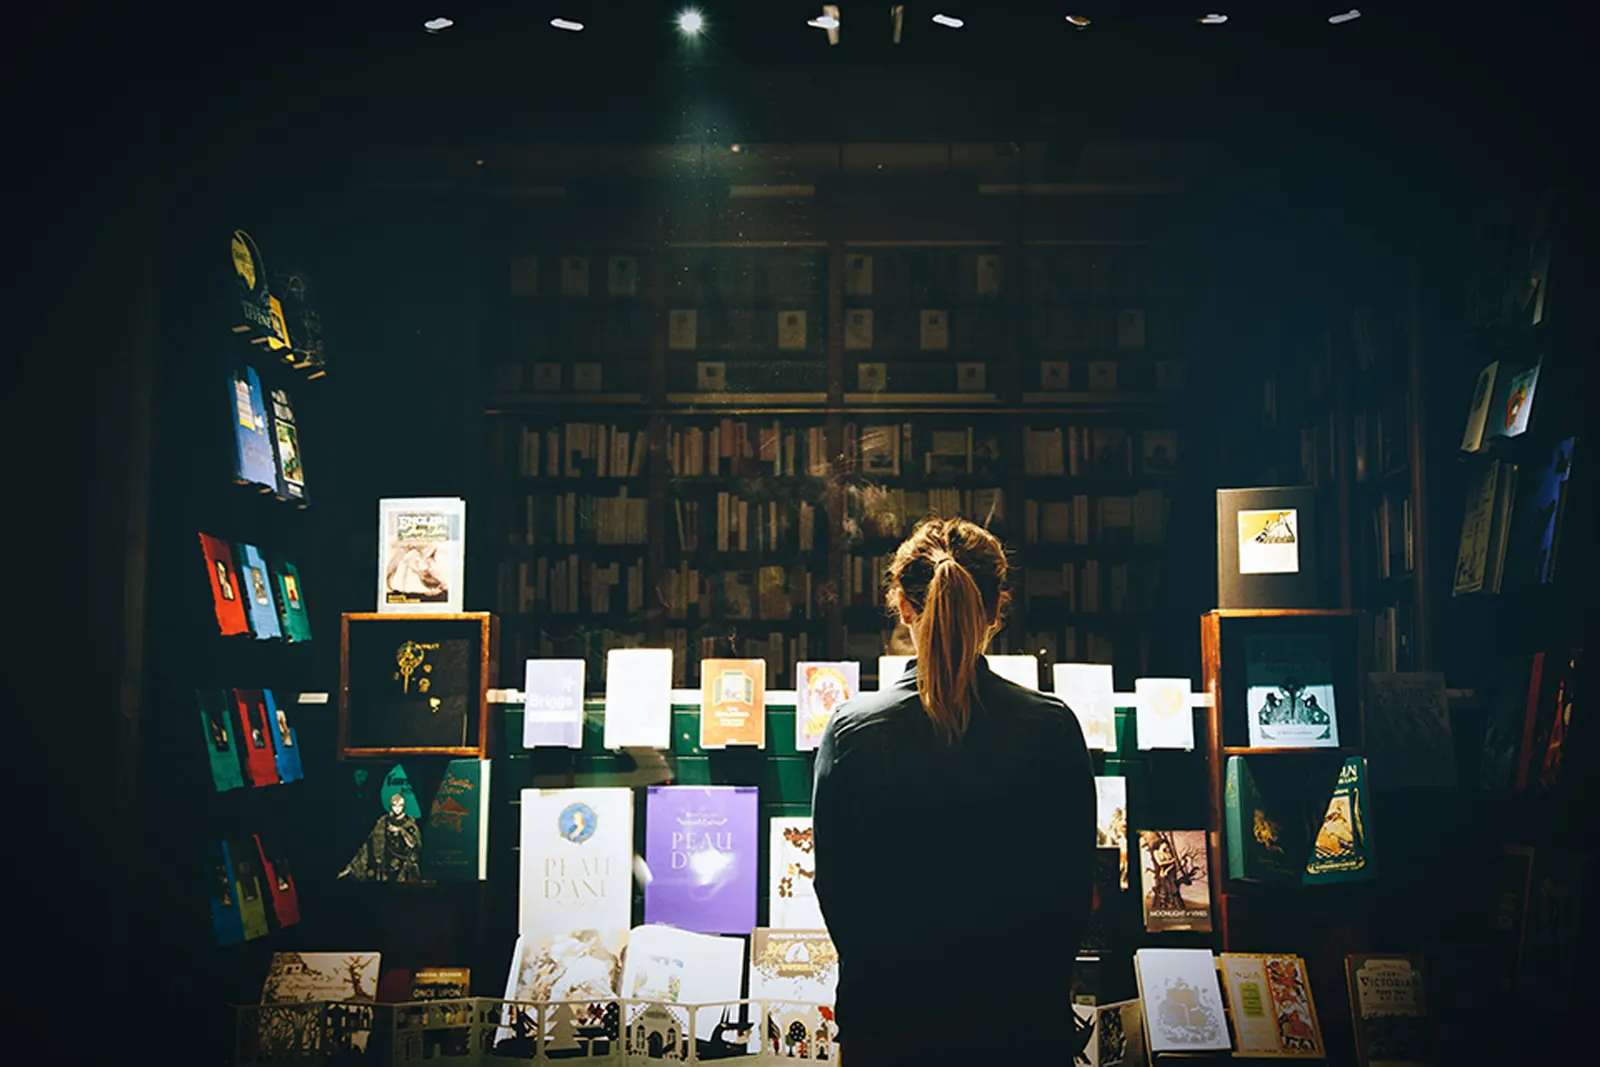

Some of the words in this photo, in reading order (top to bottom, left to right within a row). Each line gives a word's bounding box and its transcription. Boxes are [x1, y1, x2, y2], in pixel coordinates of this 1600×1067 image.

[529, 693, 574, 710] Briggs
[672, 832, 732, 850] PEAU
[413, 988, 435, 999] ONCE
